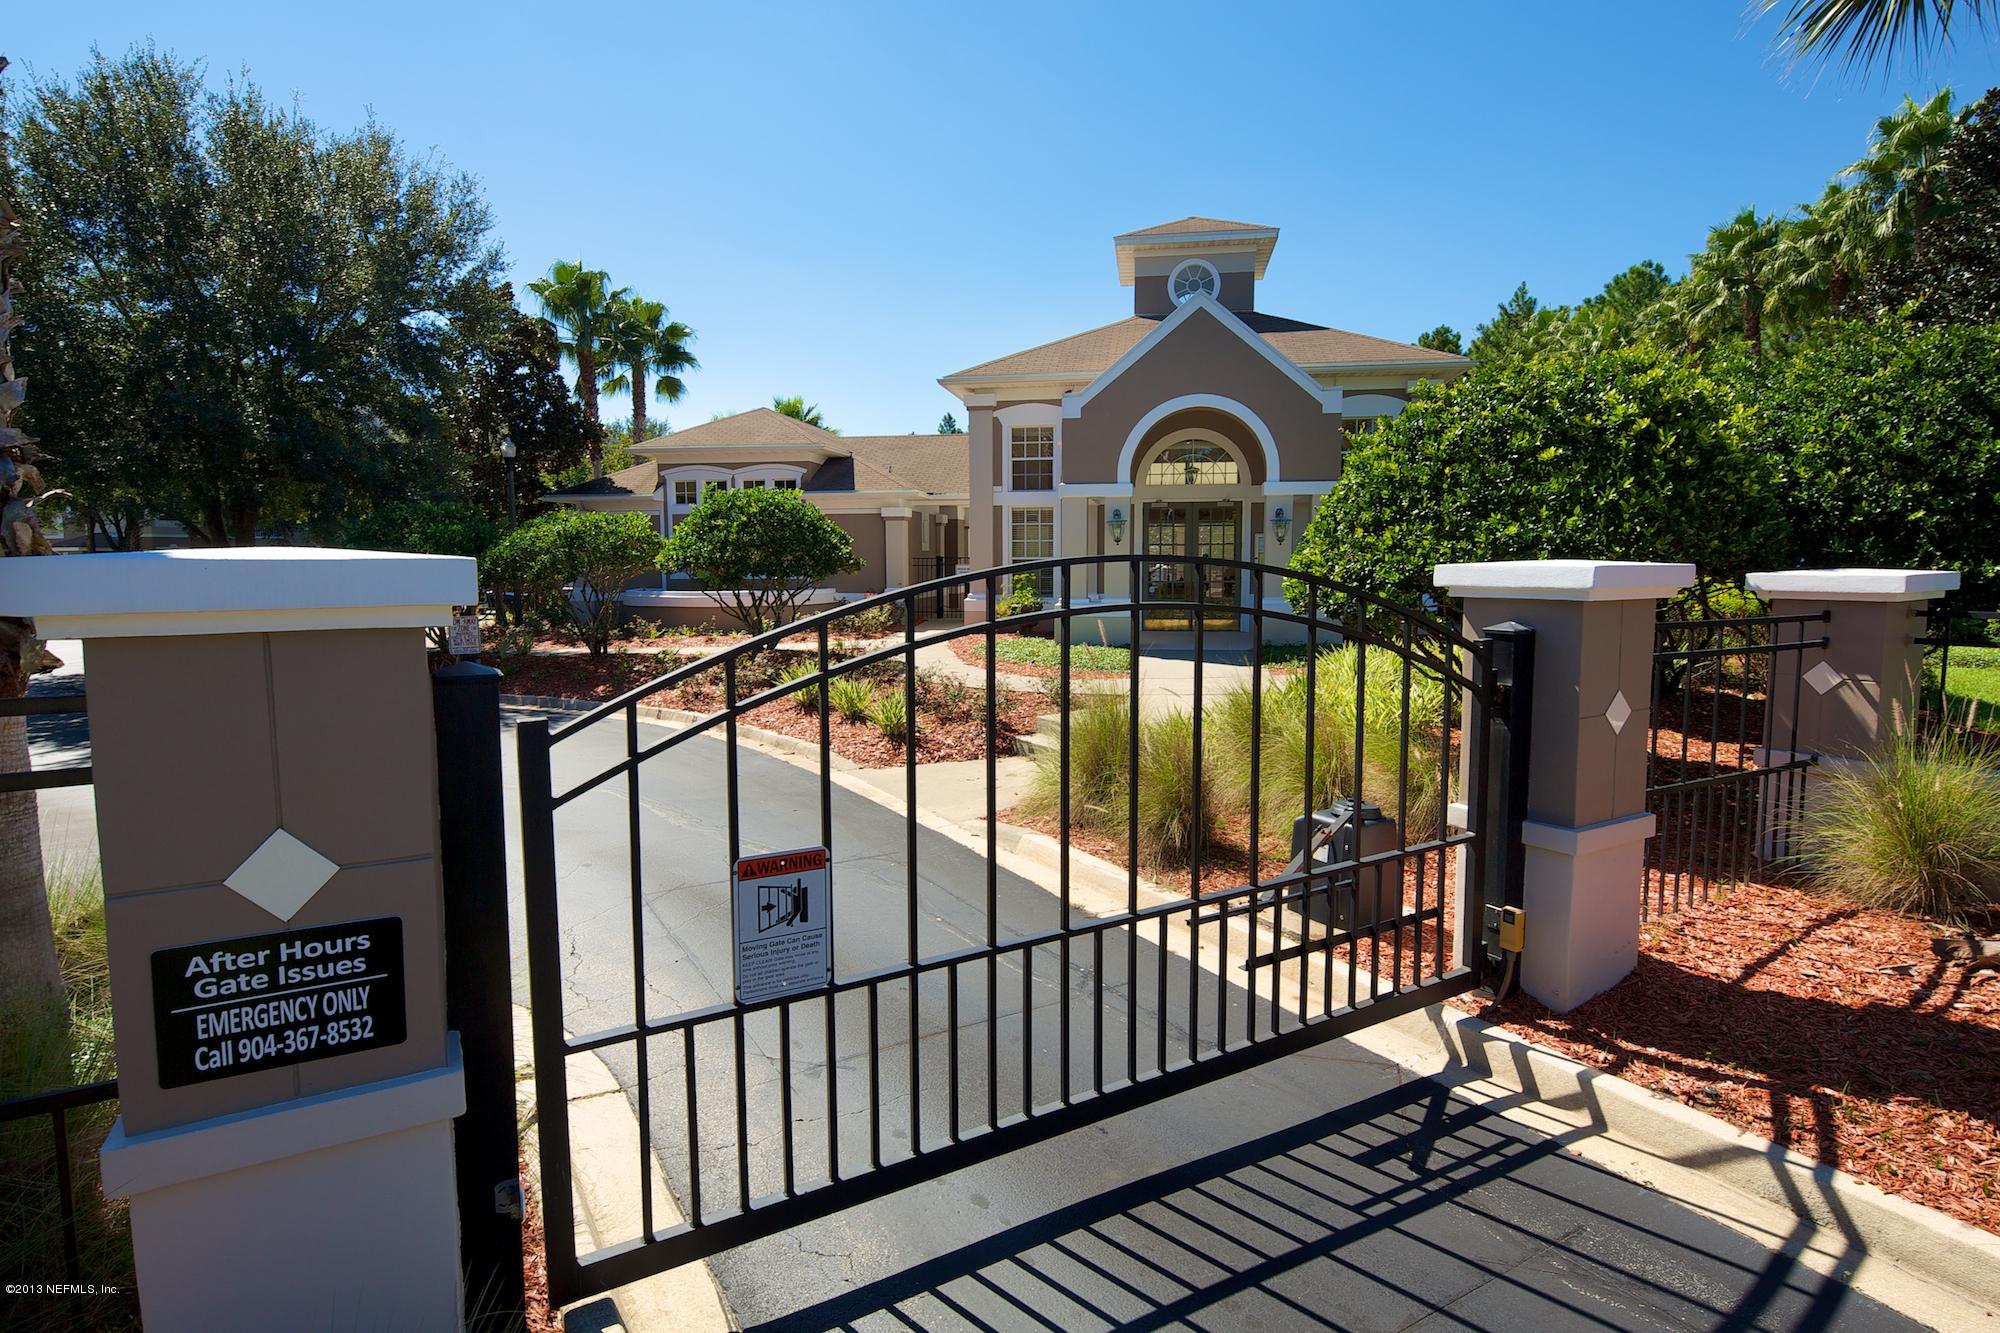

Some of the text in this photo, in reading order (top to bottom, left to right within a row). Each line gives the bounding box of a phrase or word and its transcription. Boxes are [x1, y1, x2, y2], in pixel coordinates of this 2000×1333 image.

[757, 854, 822, 874] WARNING
[184, 934, 371, 978] After Hours
[742, 944, 767, 952] Moving
[802, 933, 822, 941] Cause
[742, 952, 768, 961] Serious
[771, 947, 789, 955] Injury
[194, 957, 366, 998] Gate Issues
[196, 985, 370, 1039] EMERGENCY ONLY
[195, 1016, 374, 1071] Call 904-367-8532
